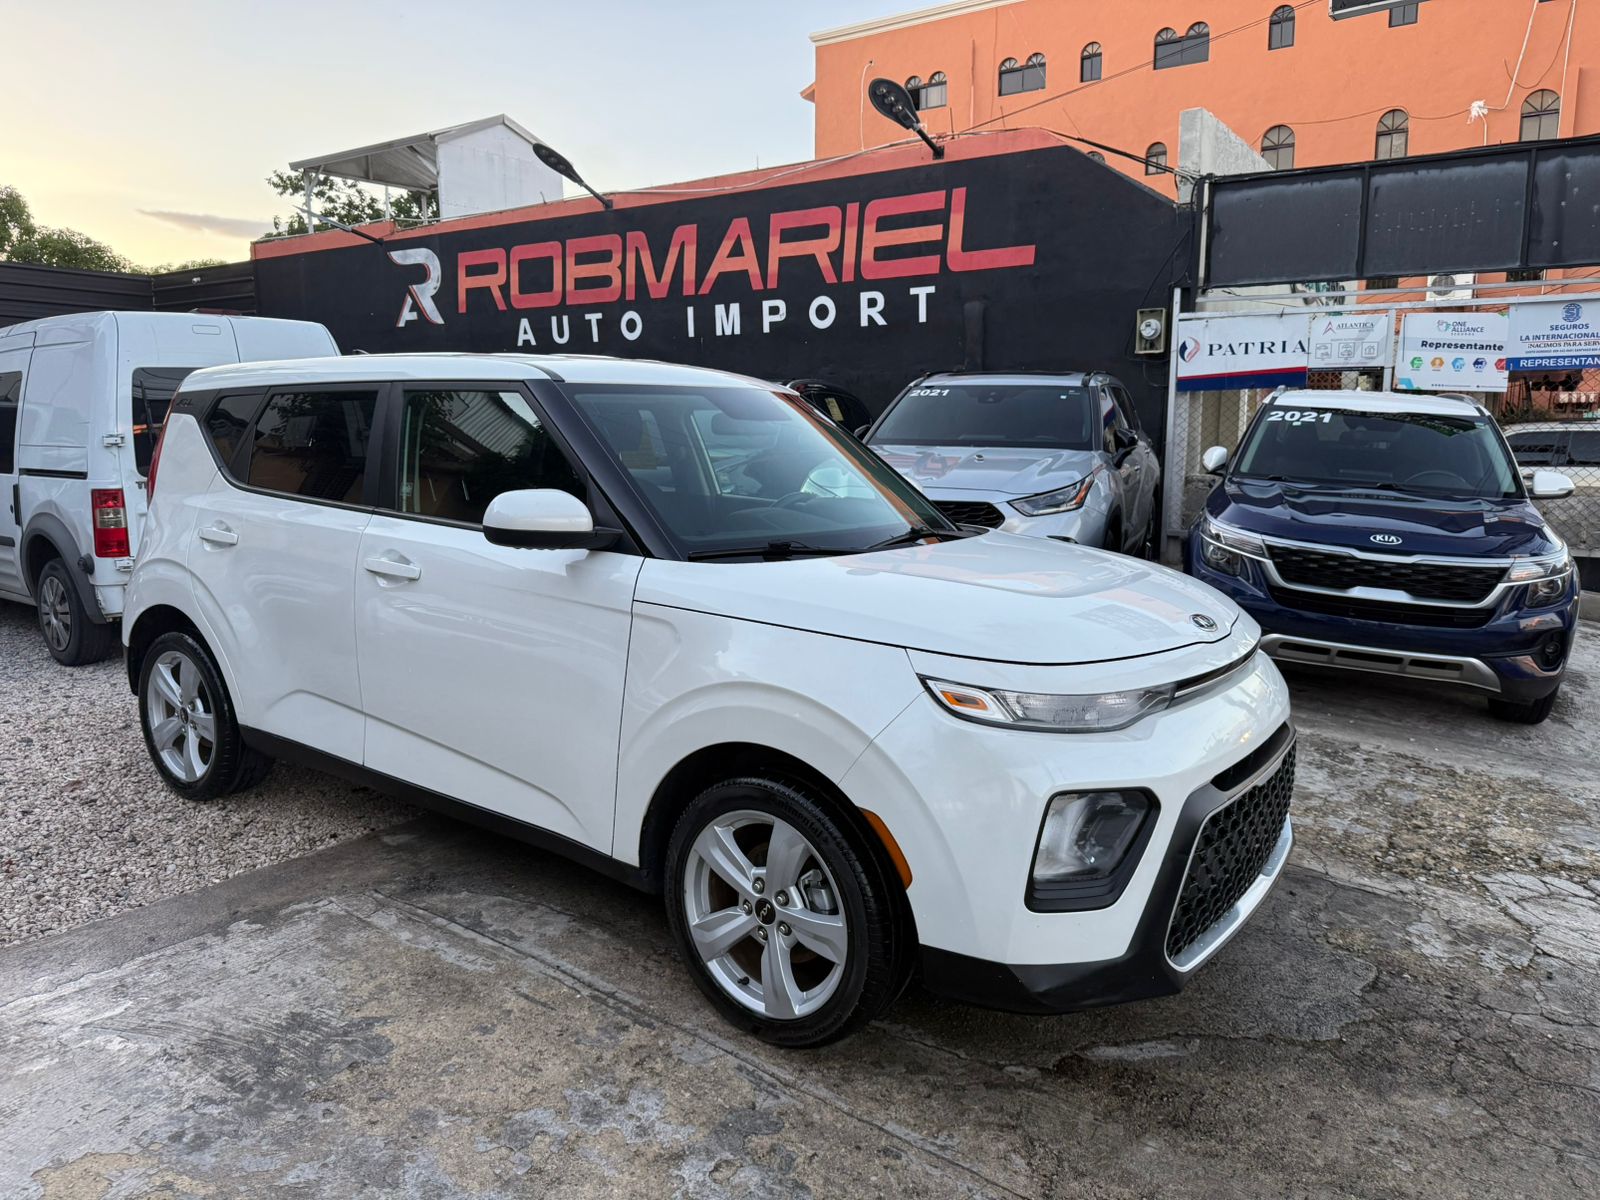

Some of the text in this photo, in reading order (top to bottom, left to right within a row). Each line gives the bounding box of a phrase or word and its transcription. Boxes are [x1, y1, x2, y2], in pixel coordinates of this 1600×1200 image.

[457, 187, 1036, 314] ROBMARIEL
[517, 285, 936, 347] AUTO IMPORT
[1336, 321, 1375, 329] ATLANTICA
[1549, 323, 1590, 331] SEGUROS
[1532, 332, 1600, 341] INTERNACIONAL
[1208, 340, 1311, 356] PATRIA
[1420, 340, 1504, 351] Representante
[910, 389, 950, 397] 2021
[1266, 411, 1332, 424] 2021
